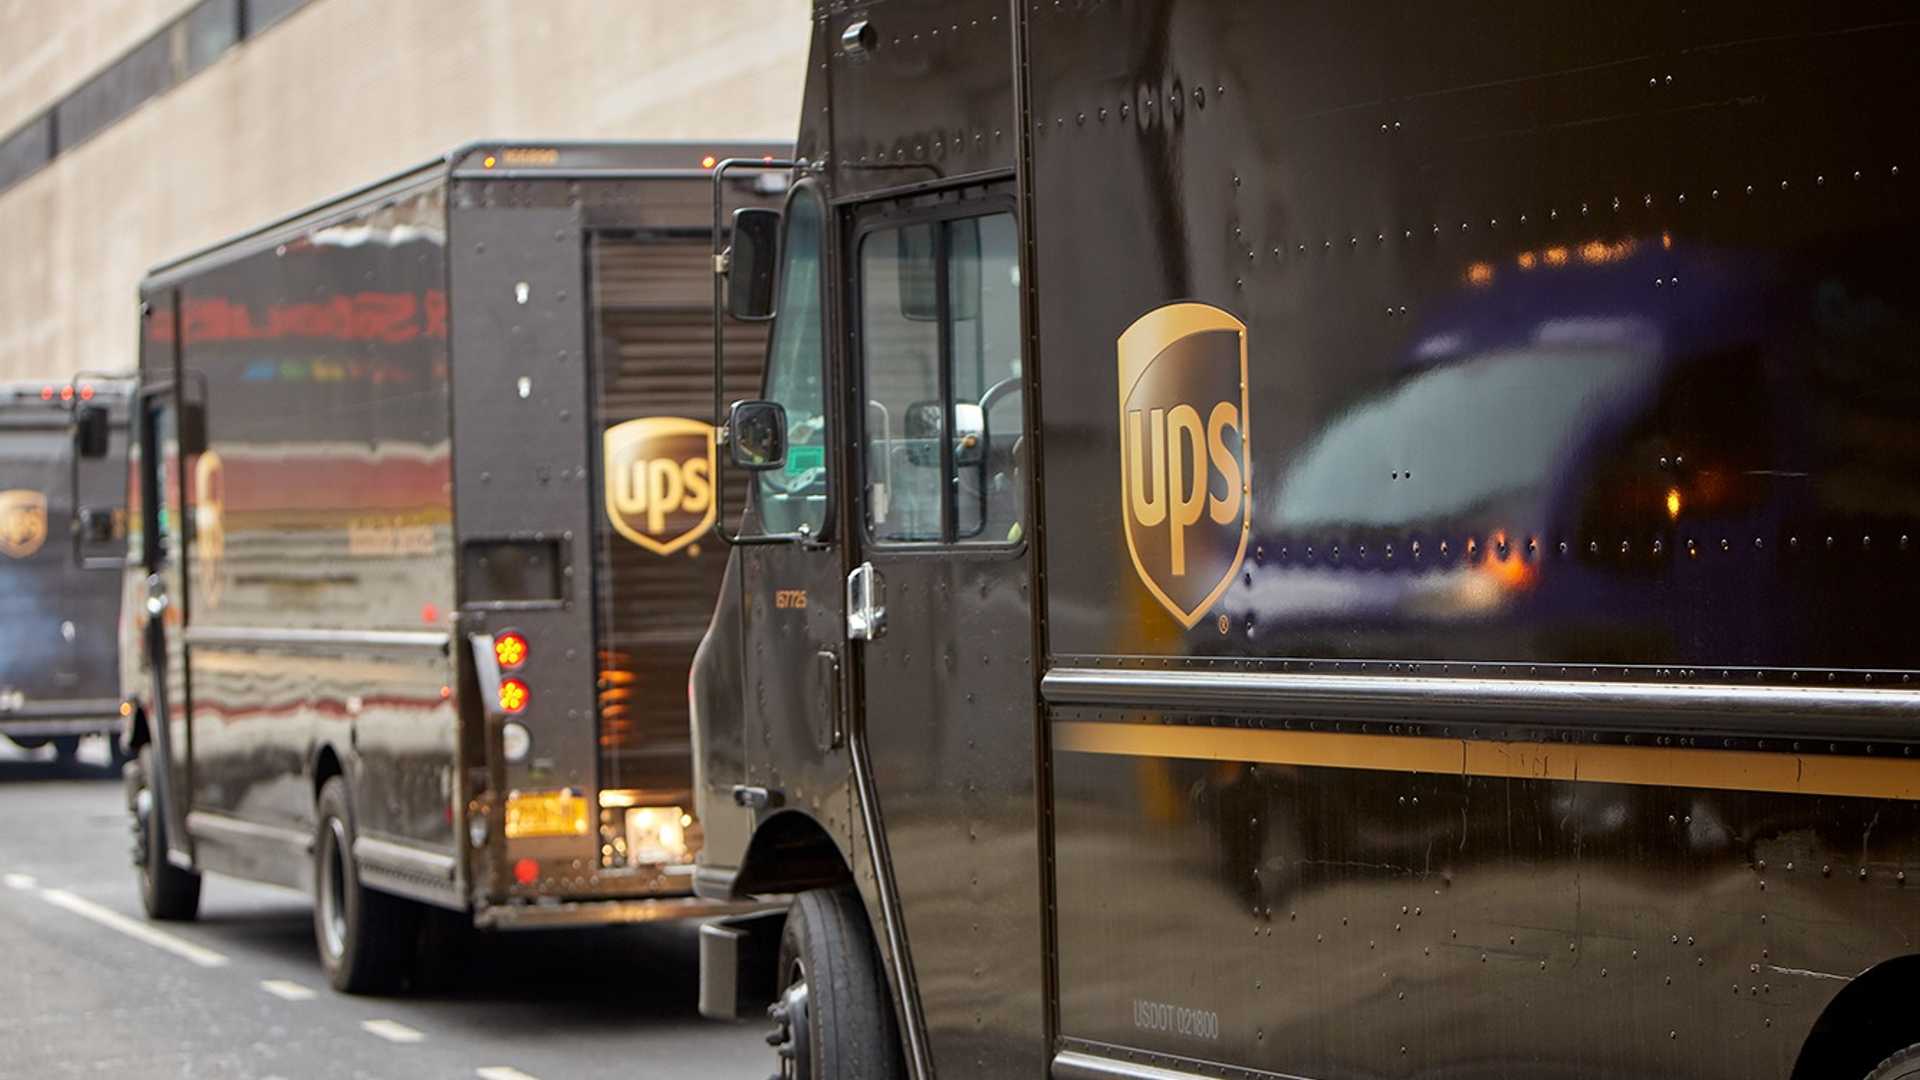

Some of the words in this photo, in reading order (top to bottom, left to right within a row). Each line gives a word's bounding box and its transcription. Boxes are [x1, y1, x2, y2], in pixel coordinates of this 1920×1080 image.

[615, 457, 710, 535] ups
[1128, 400, 1242, 576] ups
[1134, 1000, 1174, 1032] USDOT
